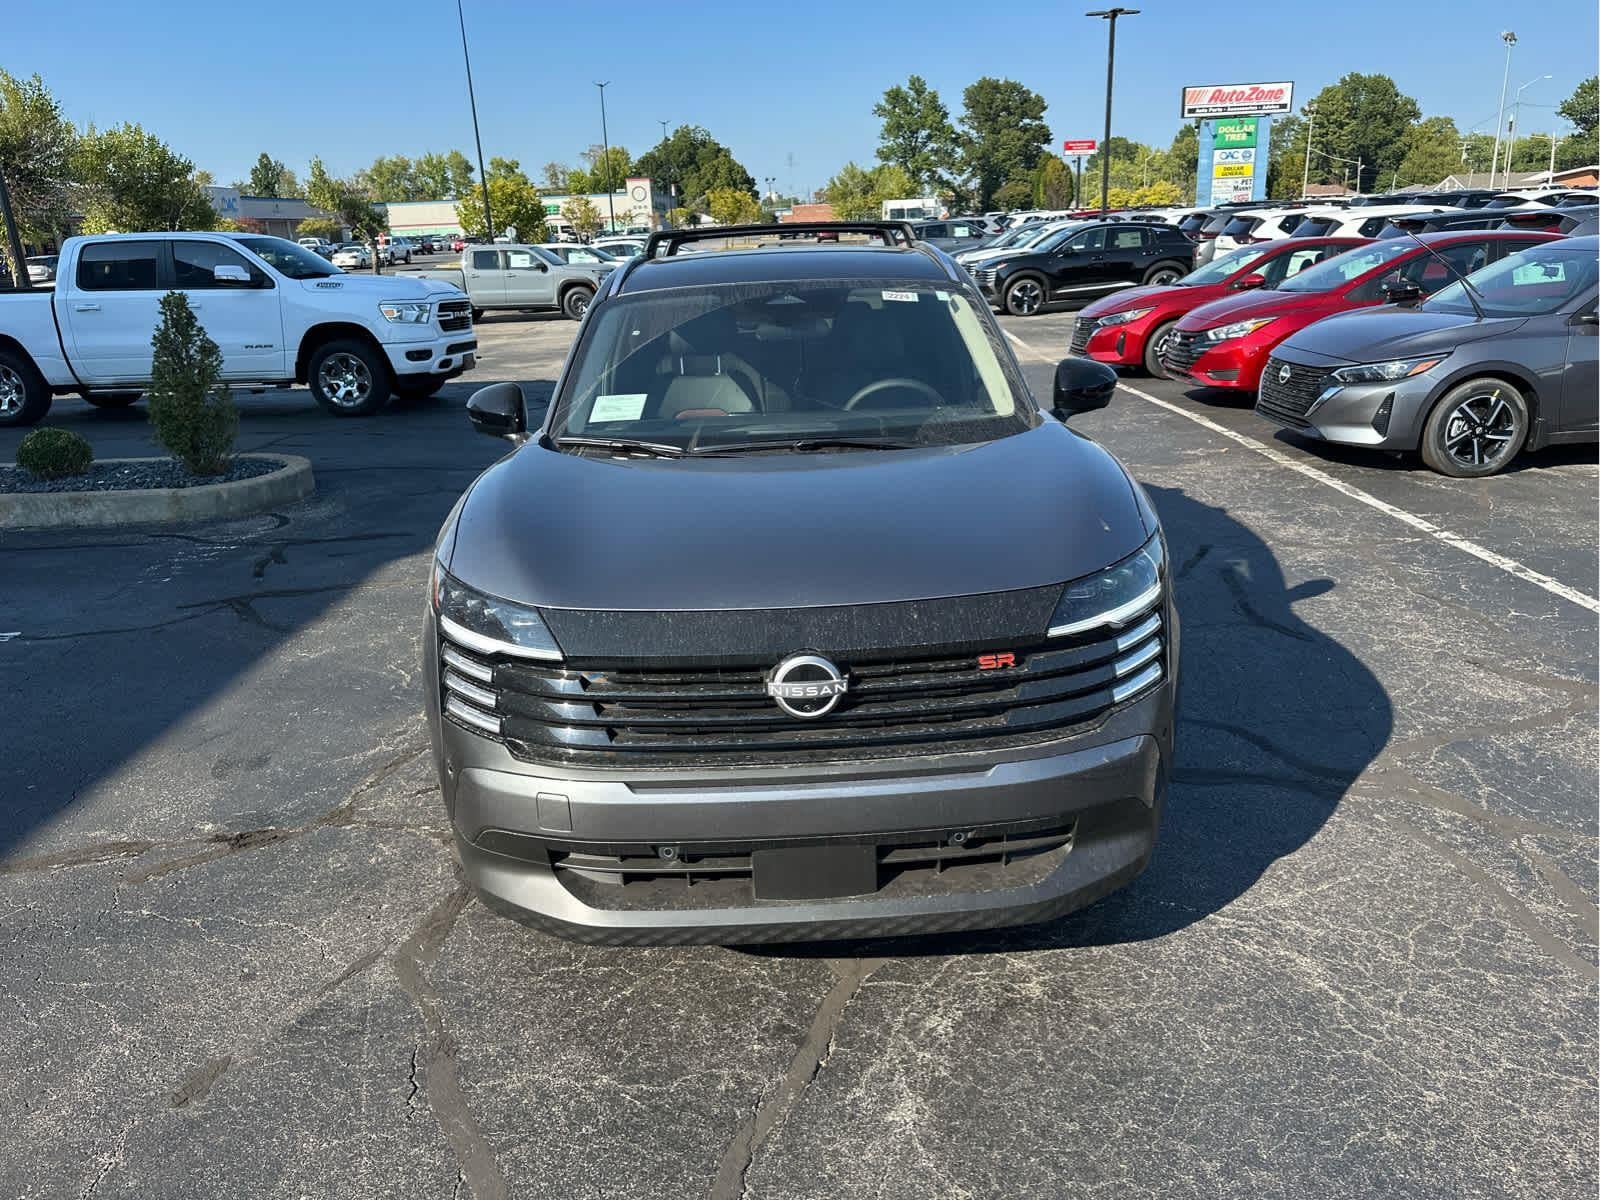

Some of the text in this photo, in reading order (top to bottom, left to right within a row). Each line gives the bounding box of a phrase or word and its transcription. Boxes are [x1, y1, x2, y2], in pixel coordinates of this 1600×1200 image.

[1208, 86, 1285, 104] AutoZone
[1218, 124, 1256, 134] DOLLAR
[1224, 133, 1247, 142] TREE
[978, 652, 1016, 670] SR
[770, 682, 847, 697] NISSAN
